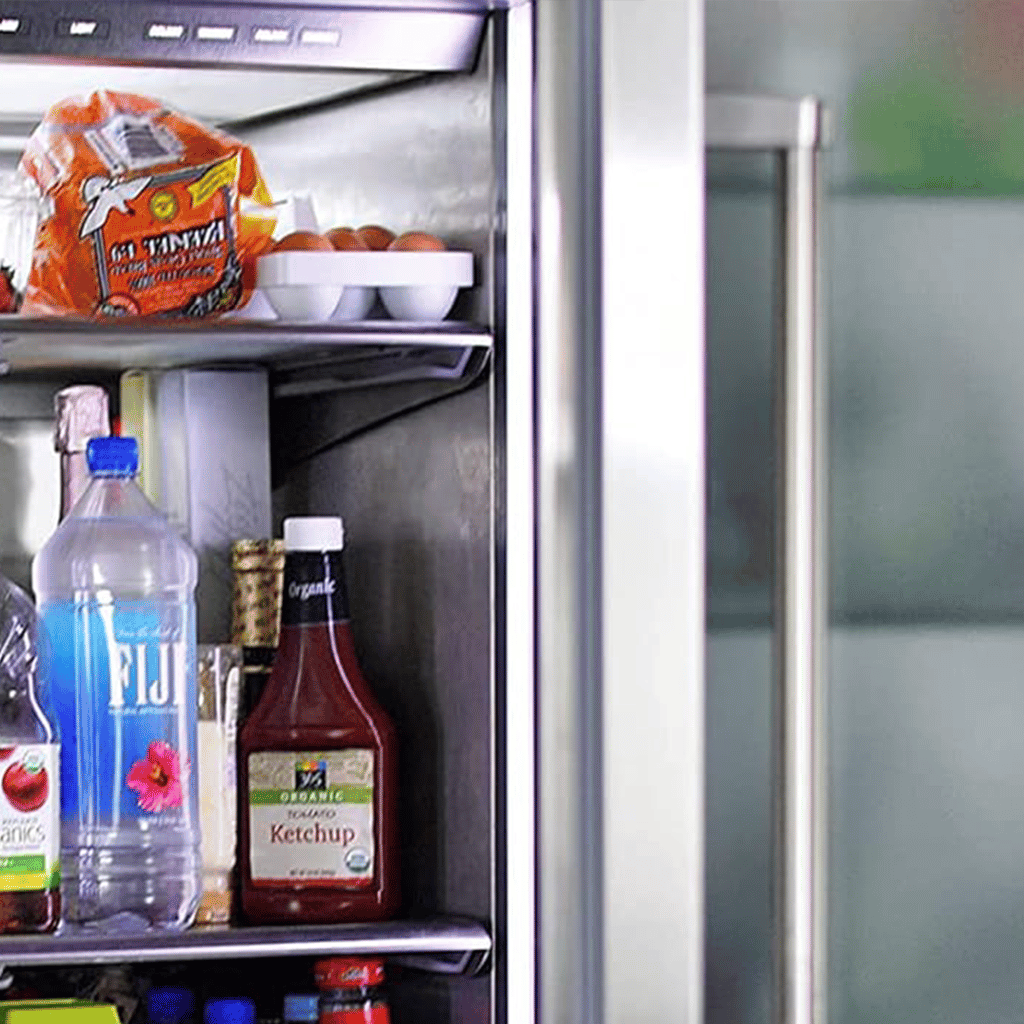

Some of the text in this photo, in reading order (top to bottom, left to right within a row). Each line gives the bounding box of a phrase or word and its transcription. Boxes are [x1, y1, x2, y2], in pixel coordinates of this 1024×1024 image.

[108, 643, 185, 705] FIJI
[280, 790, 344, 802] ORGANIC
[271, 822, 356, 847] Ketchup
